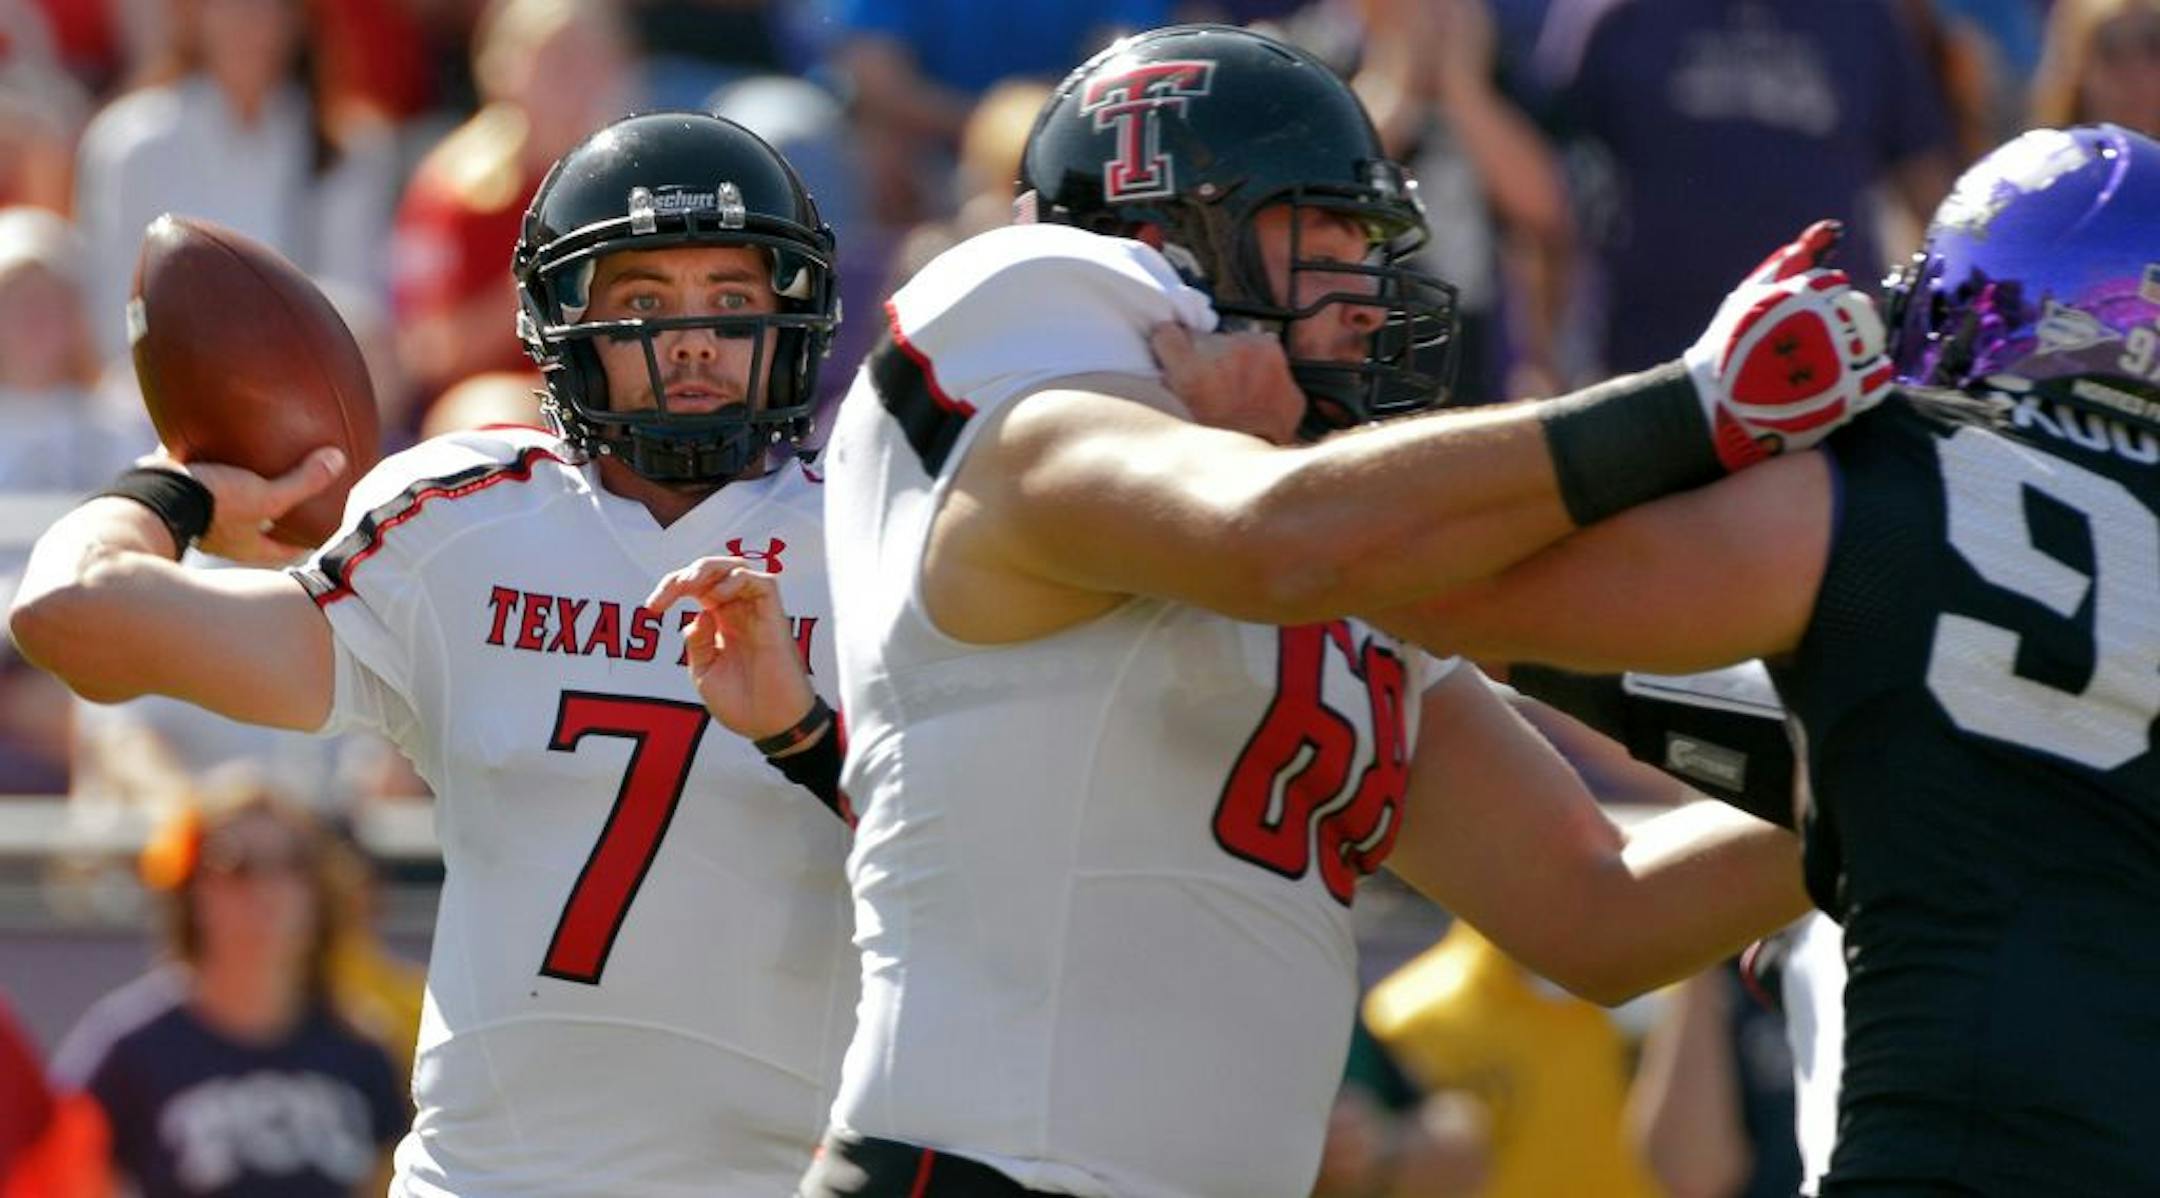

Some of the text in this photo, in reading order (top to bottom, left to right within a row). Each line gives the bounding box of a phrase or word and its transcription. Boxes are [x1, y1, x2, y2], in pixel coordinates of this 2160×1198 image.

[486, 586, 664, 663] TEXAS
[1925, 423, 2160, 771] 9
[538, 688, 713, 986] 7
[1211, 620, 1412, 909] 68
